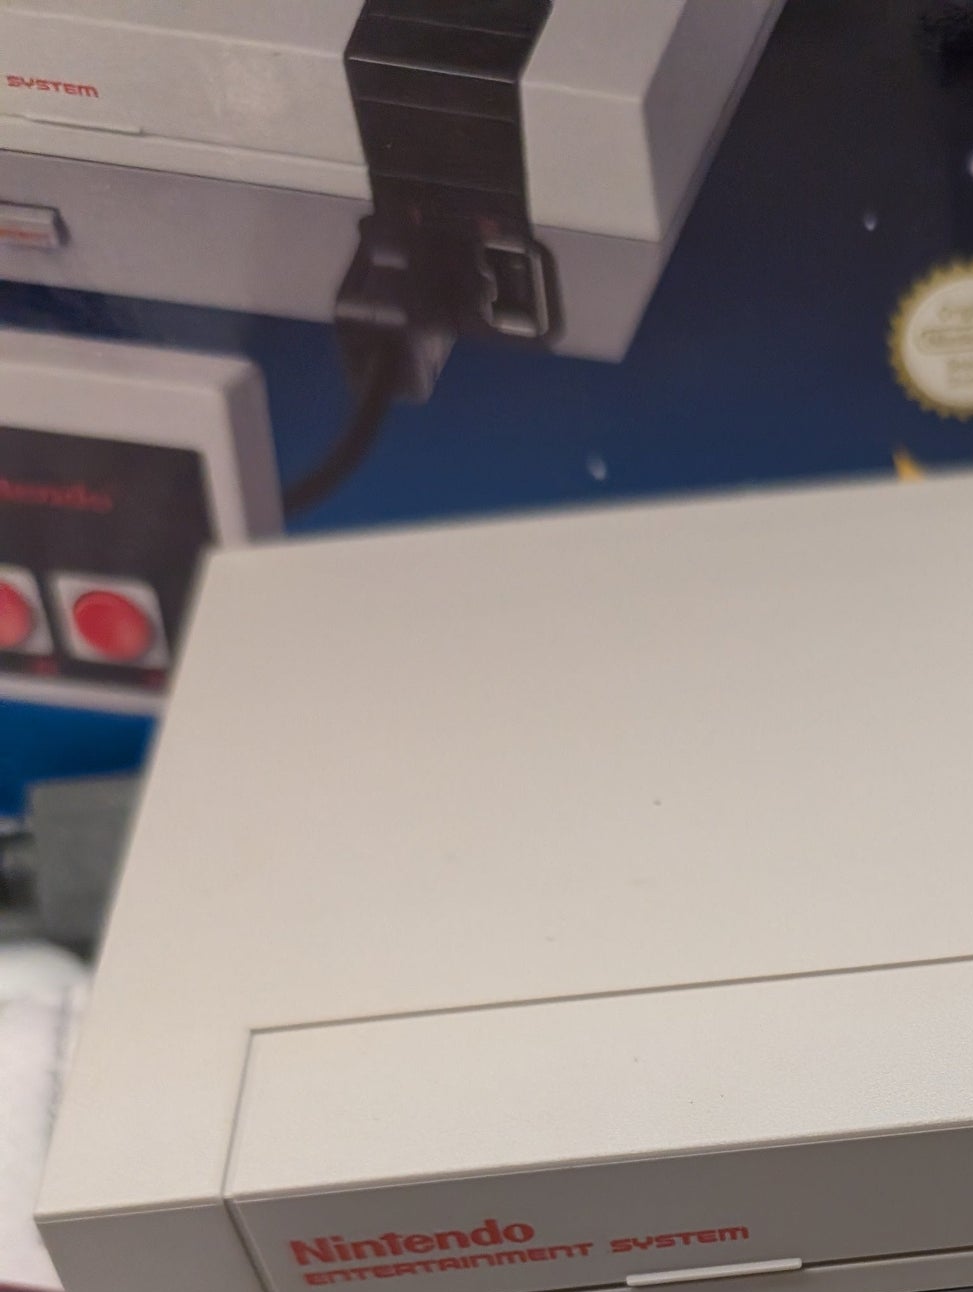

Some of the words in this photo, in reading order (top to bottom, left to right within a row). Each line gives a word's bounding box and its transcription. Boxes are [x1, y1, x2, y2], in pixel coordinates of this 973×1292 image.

[7, 75, 99, 98] SYSTEM
[289, 1219, 535, 1266] Nintendo
[304, 1241, 594, 1286] ENTERTAINMENT
[609, 1226, 749, 1254] SYSTEM
